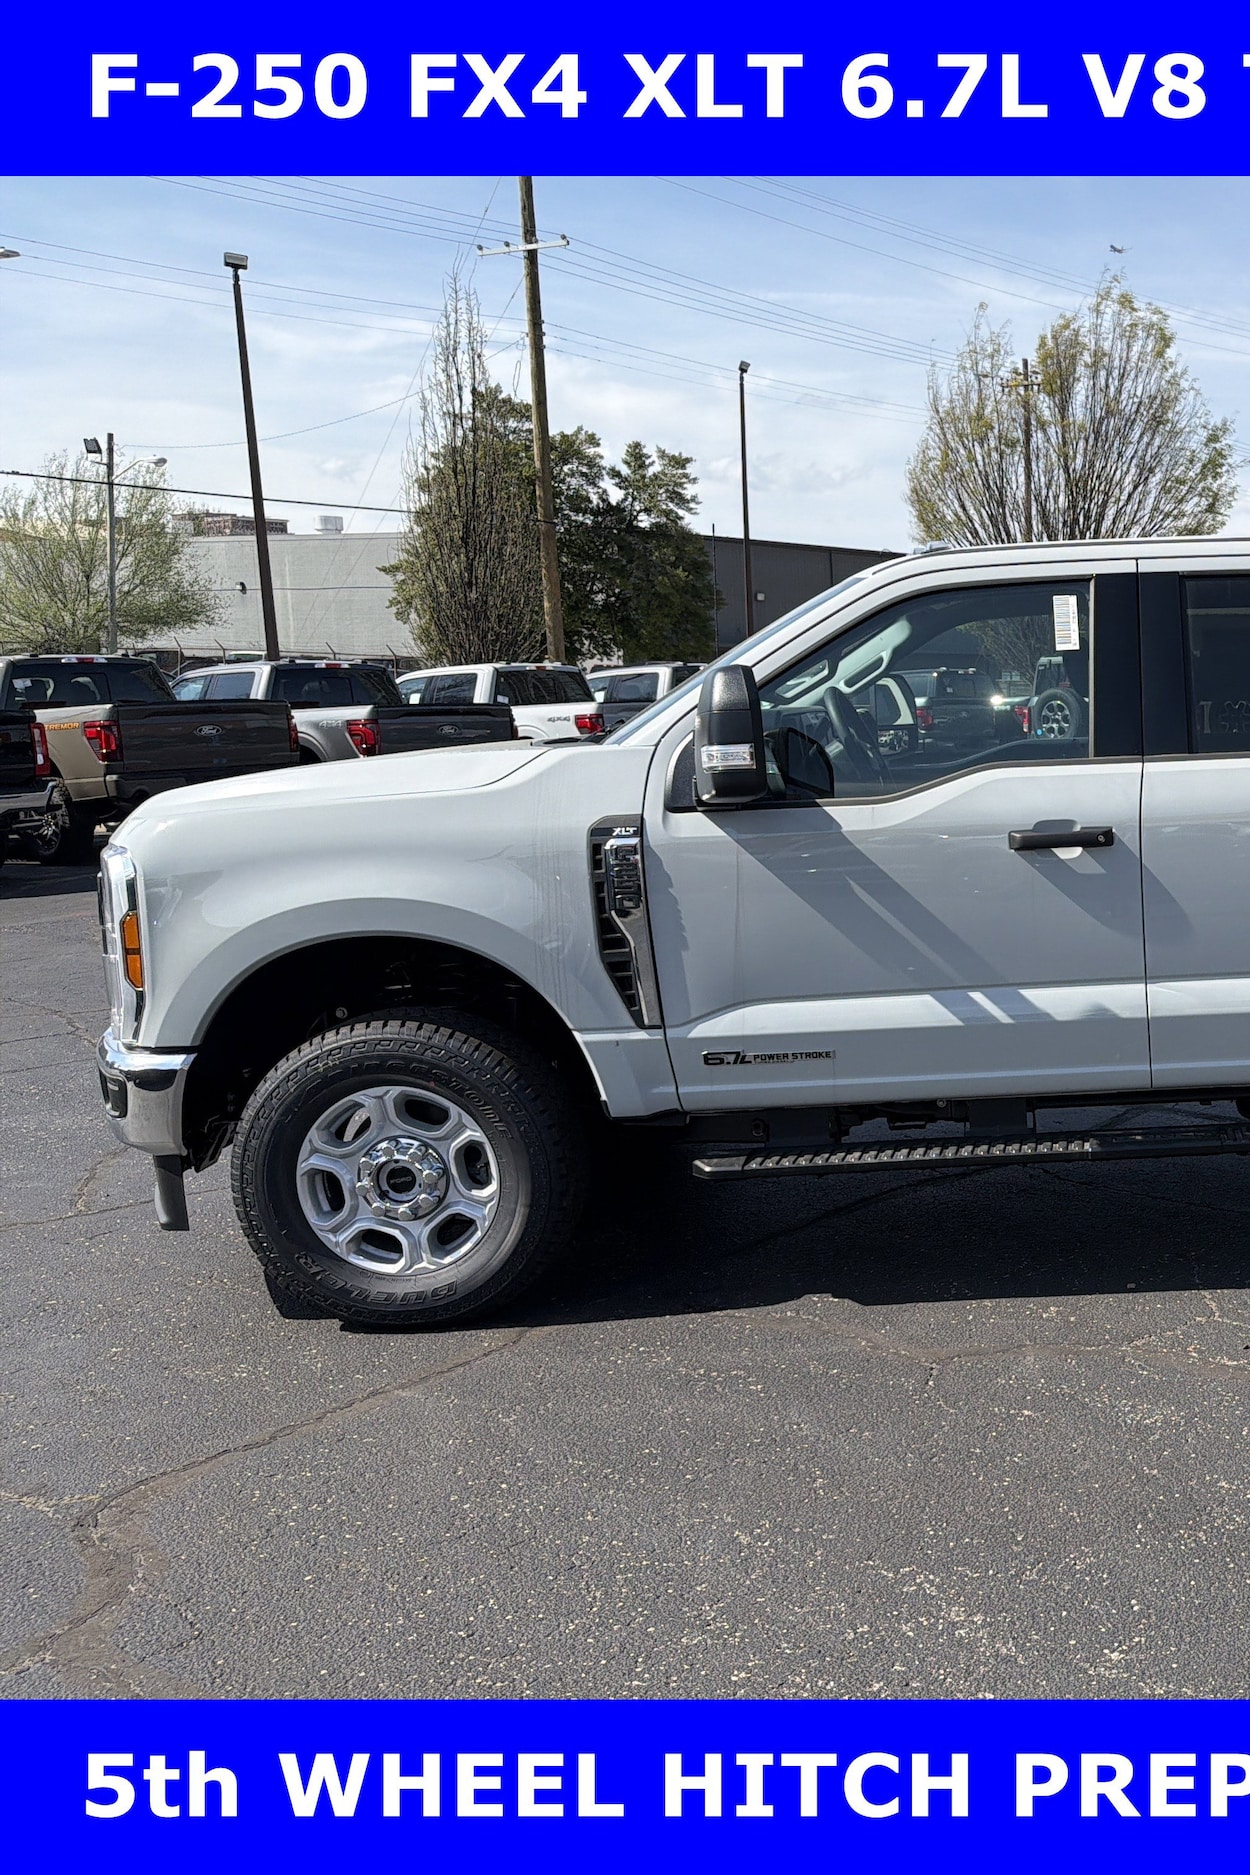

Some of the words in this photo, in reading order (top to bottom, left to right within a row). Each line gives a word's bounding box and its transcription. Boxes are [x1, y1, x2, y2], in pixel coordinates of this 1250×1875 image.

[44, 722, 80, 731] TREMOR
[612, 827, 637, 836] XLT
[702, 1050, 752, 1066] 6.7L
[754, 1052, 789, 1061] POWER
[791, 1050, 832, 1060] STROKE
